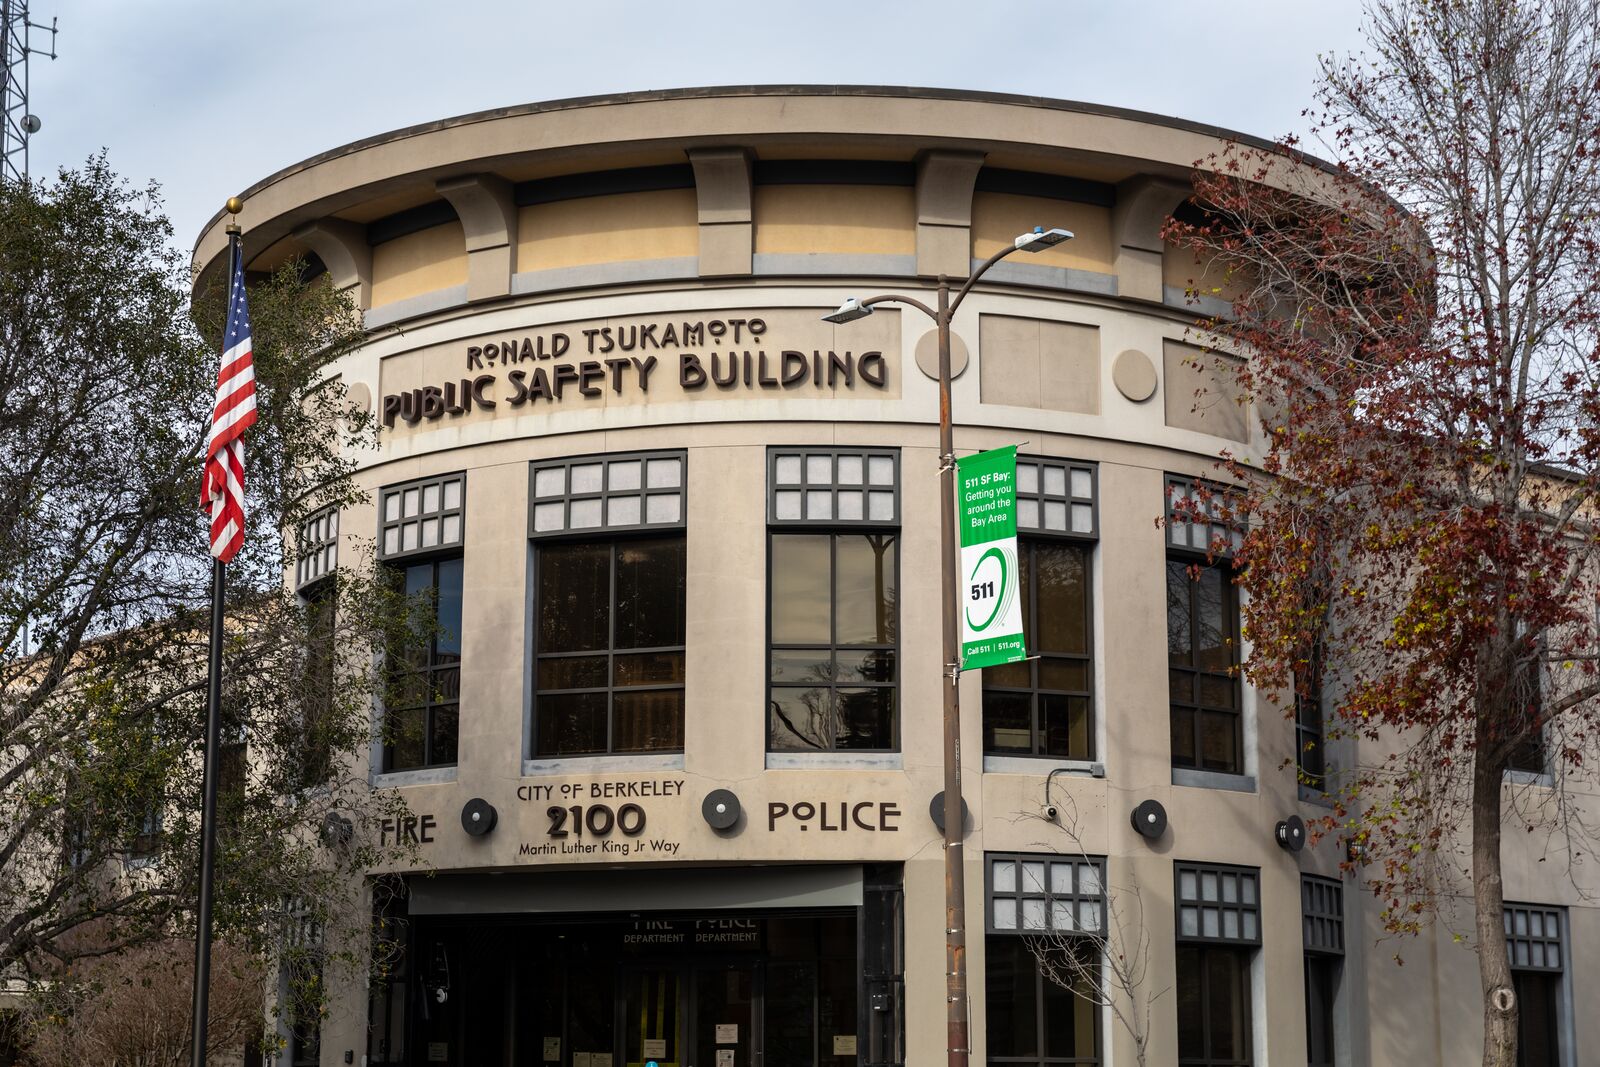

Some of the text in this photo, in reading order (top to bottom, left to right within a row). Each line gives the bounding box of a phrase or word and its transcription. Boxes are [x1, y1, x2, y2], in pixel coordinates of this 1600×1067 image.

[467, 318, 767, 371] RONALD TSUKAMOTO
[383, 350, 887, 429] PUBLIC SAFETY BUILDING
[965, 472, 1011, 488] 511 SF Bay:
[965, 485, 1012, 502] Getting you
[967, 498, 1011, 515] around the
[971, 513, 1007, 528] Bay Area
[971, 581, 994, 601] 511
[967, 641, 1021, 655] Call 511 511.org
[517, 780, 685, 801] CITY OF BERKELEY
[546, 803, 647, 837] 2100
[768, 801, 902, 832] POLICE
[380, 814, 437, 847] FIRE
[519, 839, 680, 856] Martin Luther King Jr Way
[623, 934, 685, 943] DEPARTMENT
[695, 933, 758, 943] DEPARTMENT
